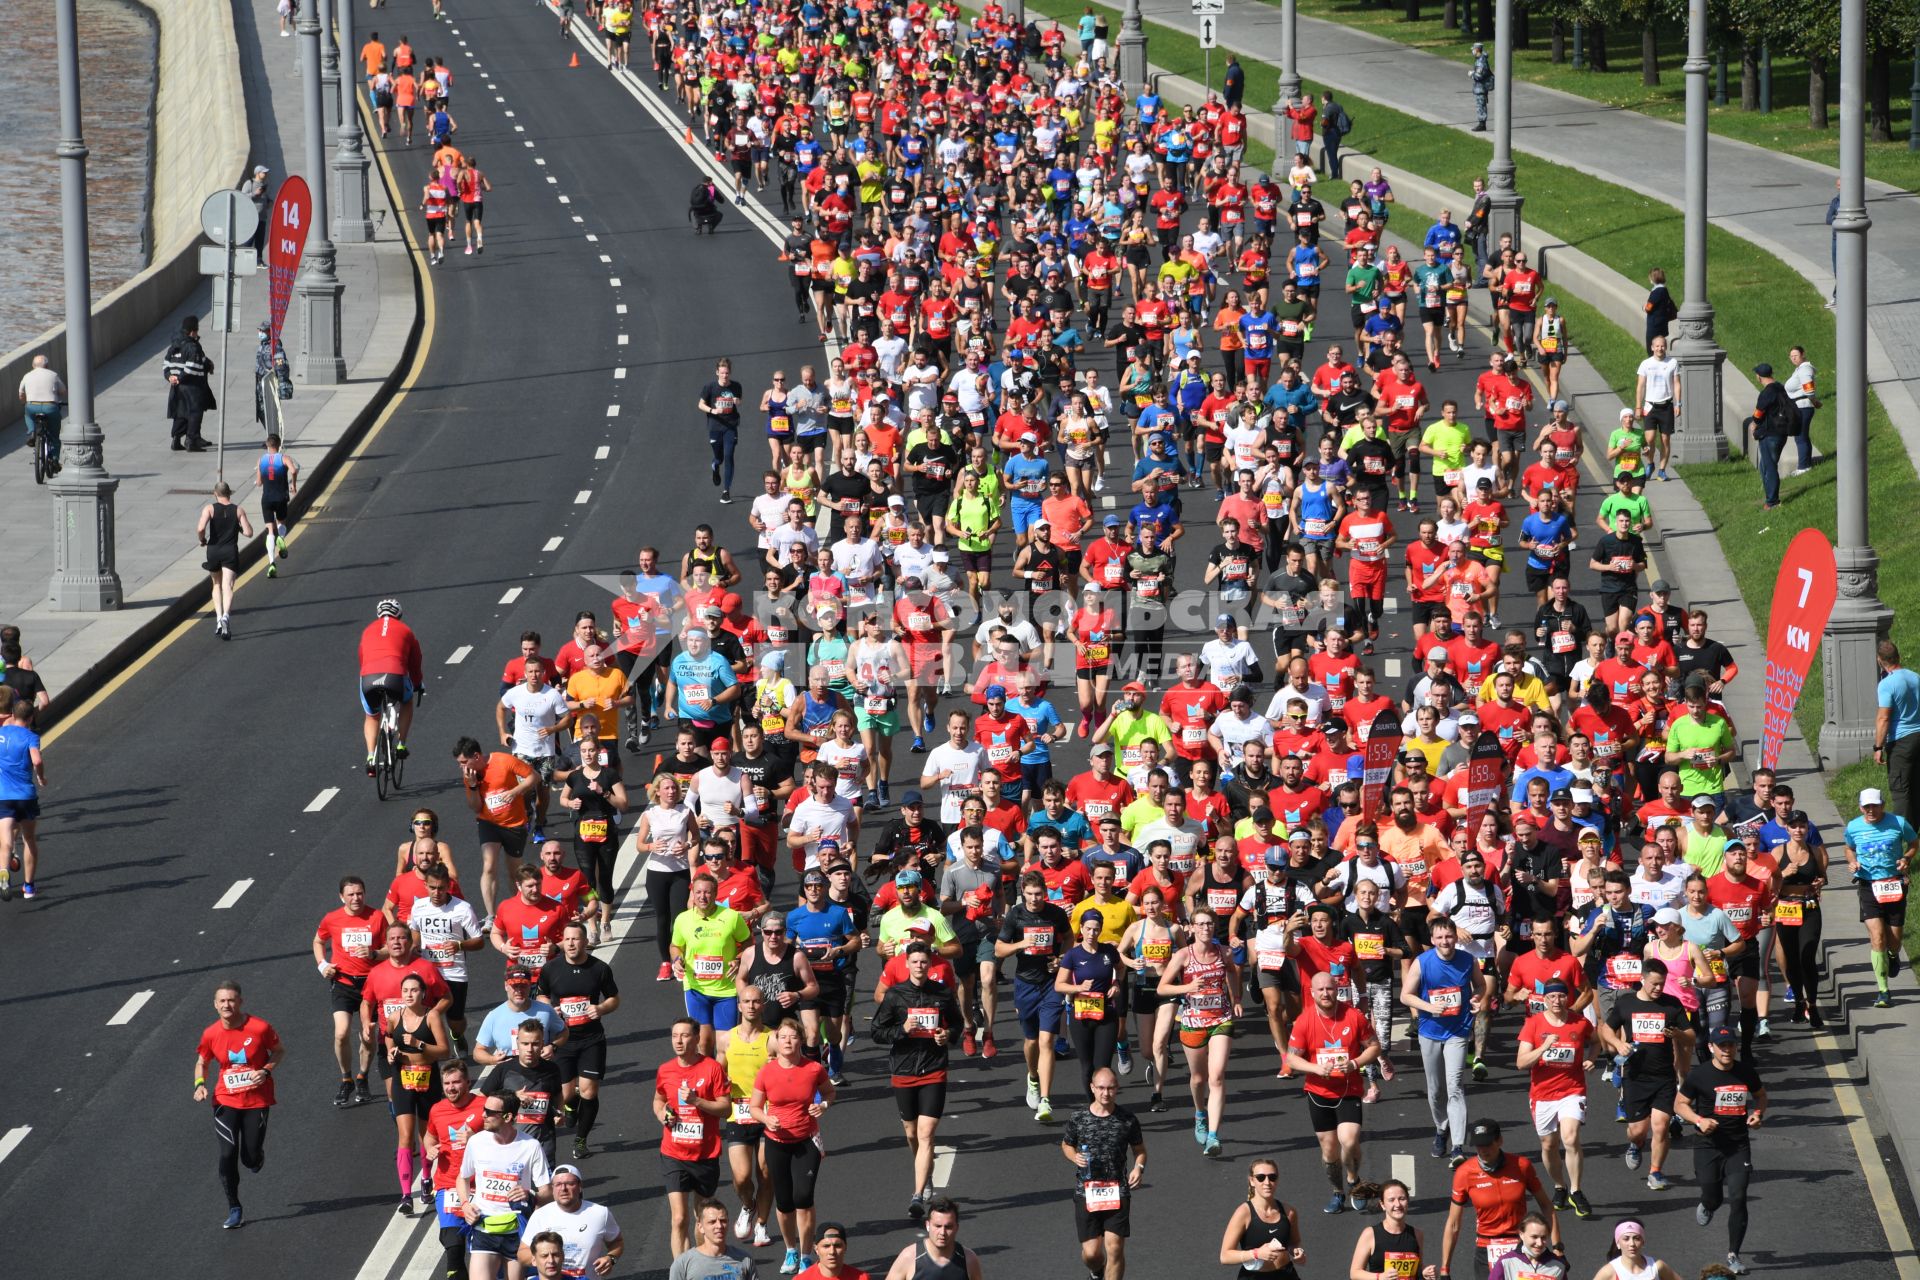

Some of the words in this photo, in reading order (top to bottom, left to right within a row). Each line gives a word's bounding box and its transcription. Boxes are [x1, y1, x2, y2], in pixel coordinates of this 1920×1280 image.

[282, 200, 299, 229] 14
[1797, 567, 1813, 609] 7
[687, 689, 704, 698] 3065
[1375, 723, 1397, 731] SUUNTO
[1187, 730, 1202, 739] 709
[1477, 744, 1498, 752] SUUNTO
[991, 750, 1010, 759] 6225
[582, 823, 607, 833] 11894
[1873, 882, 1899, 893] 11835
[1209, 894, 1235, 904] 13748
[1727, 908, 1750, 918] 9704
[1777, 905, 1798, 914] 6741
[346, 934, 367, 943] 7381
[1144, 945, 1171, 955] 12351
[520, 955, 543, 965] 9922
[695, 960, 722, 971] 11809
[1617, 961, 1637, 970] 6274
[1079, 998, 1100, 1008] 1125
[1192, 997, 1221, 1007] 12672
[565, 1003, 587, 1014] 7592
[1637, 1020, 1661, 1030] 7056
[1546, 1048, 1571, 1059] 2967
[405, 1071, 427, 1082] 5145
[1720, 1092, 1743, 1102] 4856
[486, 1179, 512, 1192] 2266
